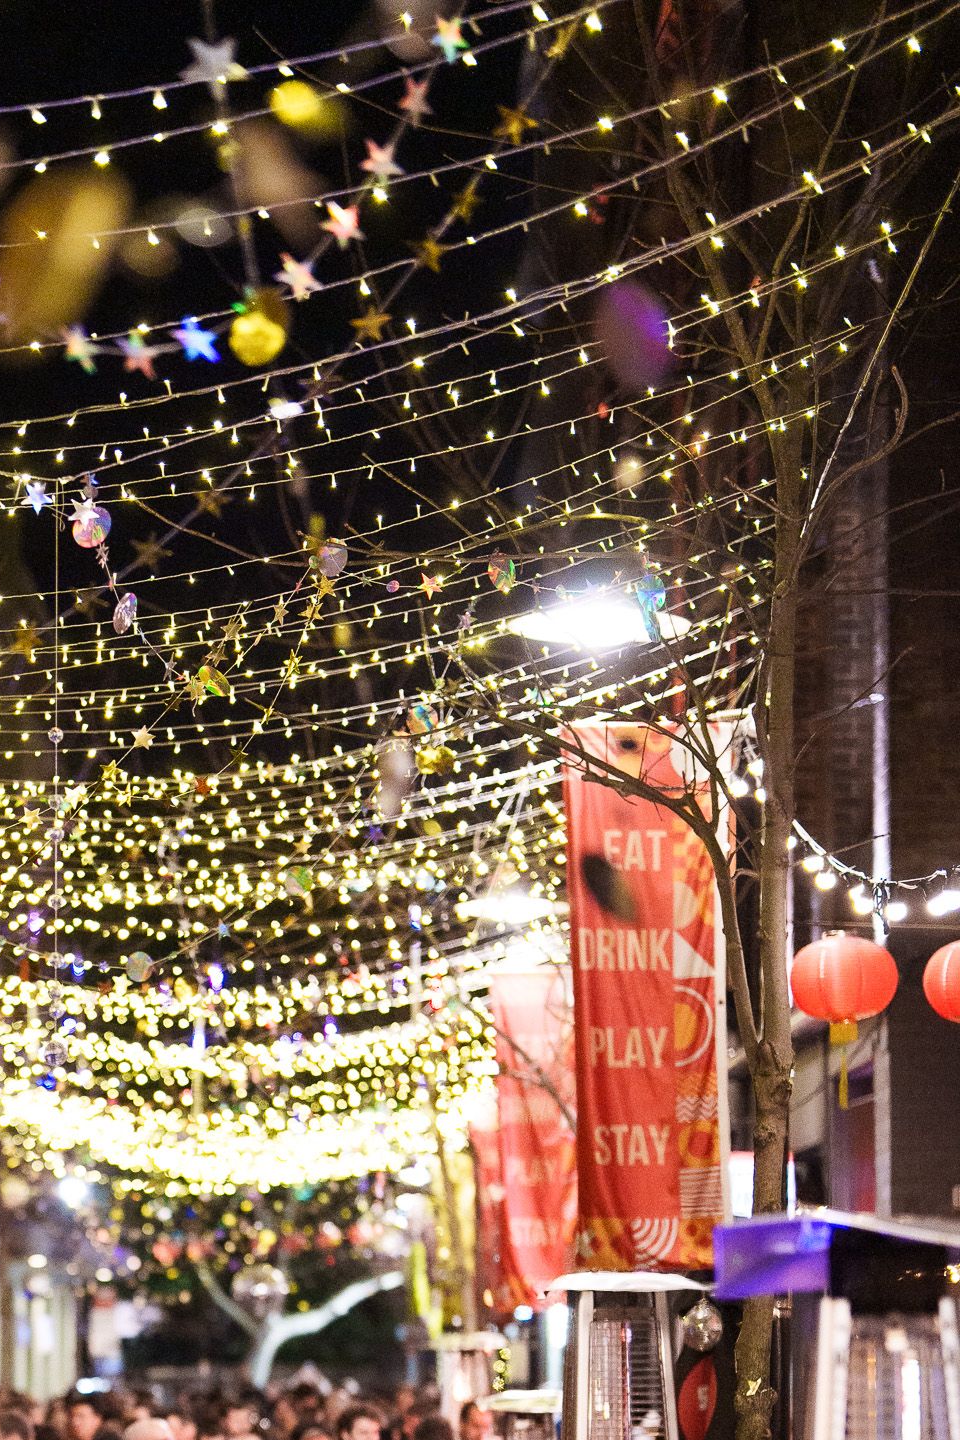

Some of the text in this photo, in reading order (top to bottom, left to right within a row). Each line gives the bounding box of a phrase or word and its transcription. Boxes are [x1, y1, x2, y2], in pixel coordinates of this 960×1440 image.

[603, 829, 668, 872] EAT
[578, 927, 671, 972] DRINK
[590, 1026, 669, 1069] PLAY
[594, 1124, 670, 1167] STAY
